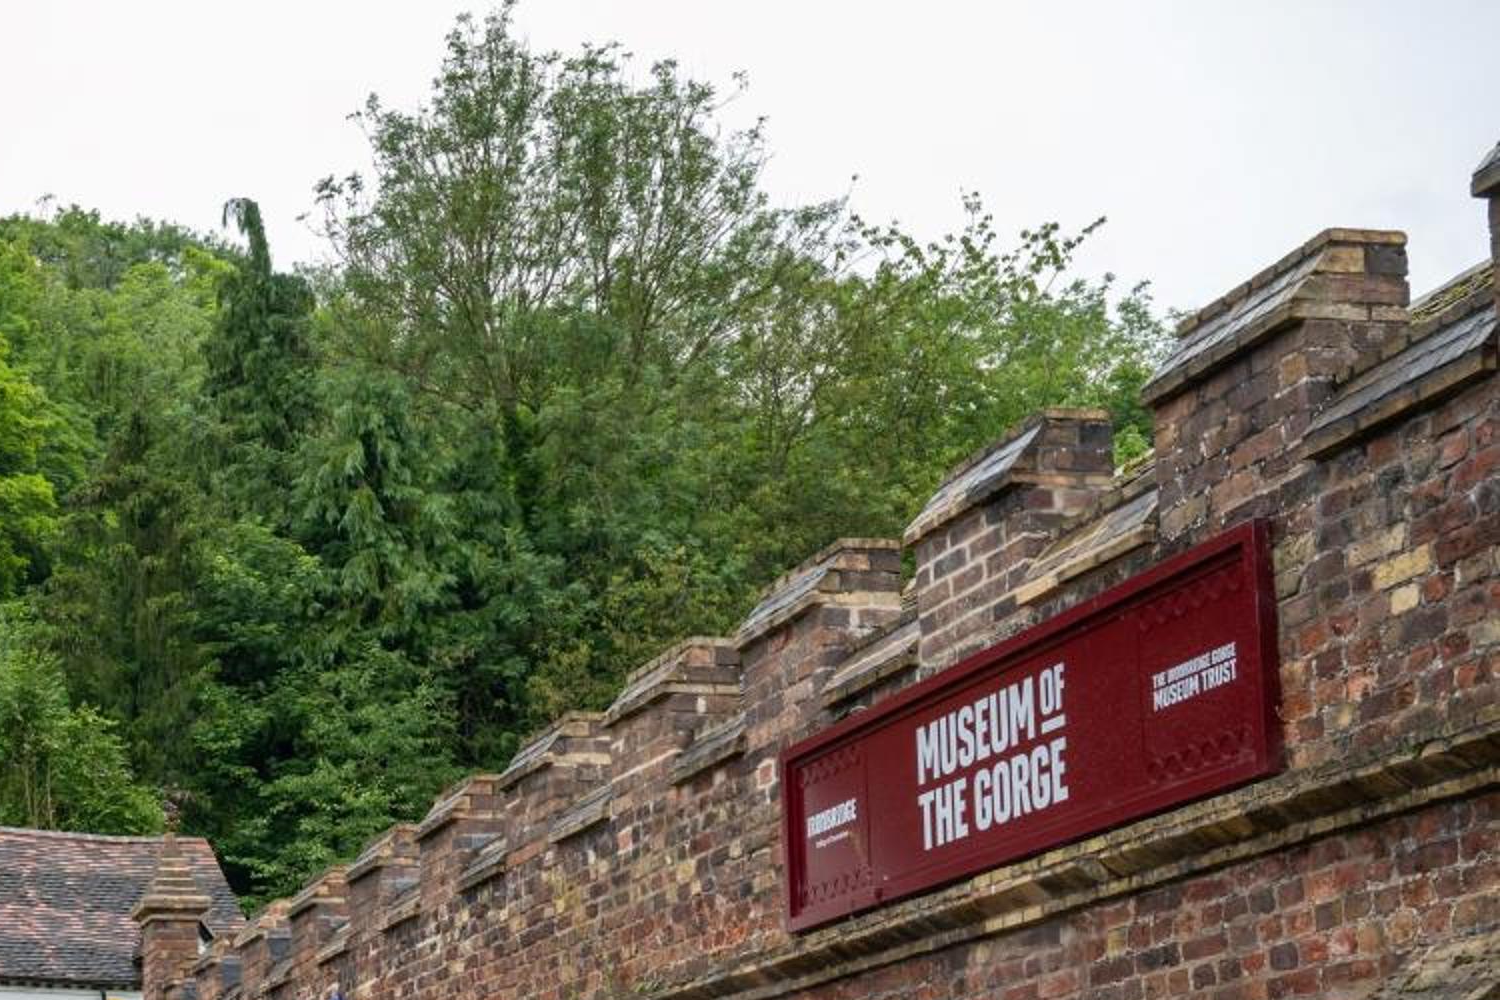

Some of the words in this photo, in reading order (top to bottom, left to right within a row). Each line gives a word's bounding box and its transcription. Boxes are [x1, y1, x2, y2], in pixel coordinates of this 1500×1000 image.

[915, 673, 1036, 786] MUSEUM
[1041, 662, 1067, 716] OF
[1153, 673, 1200, 712] MUSEUM
[1201, 658, 1237, 692] TRUST
[918, 780, 969, 852] THE
[974, 737, 1069, 831] GORGE
